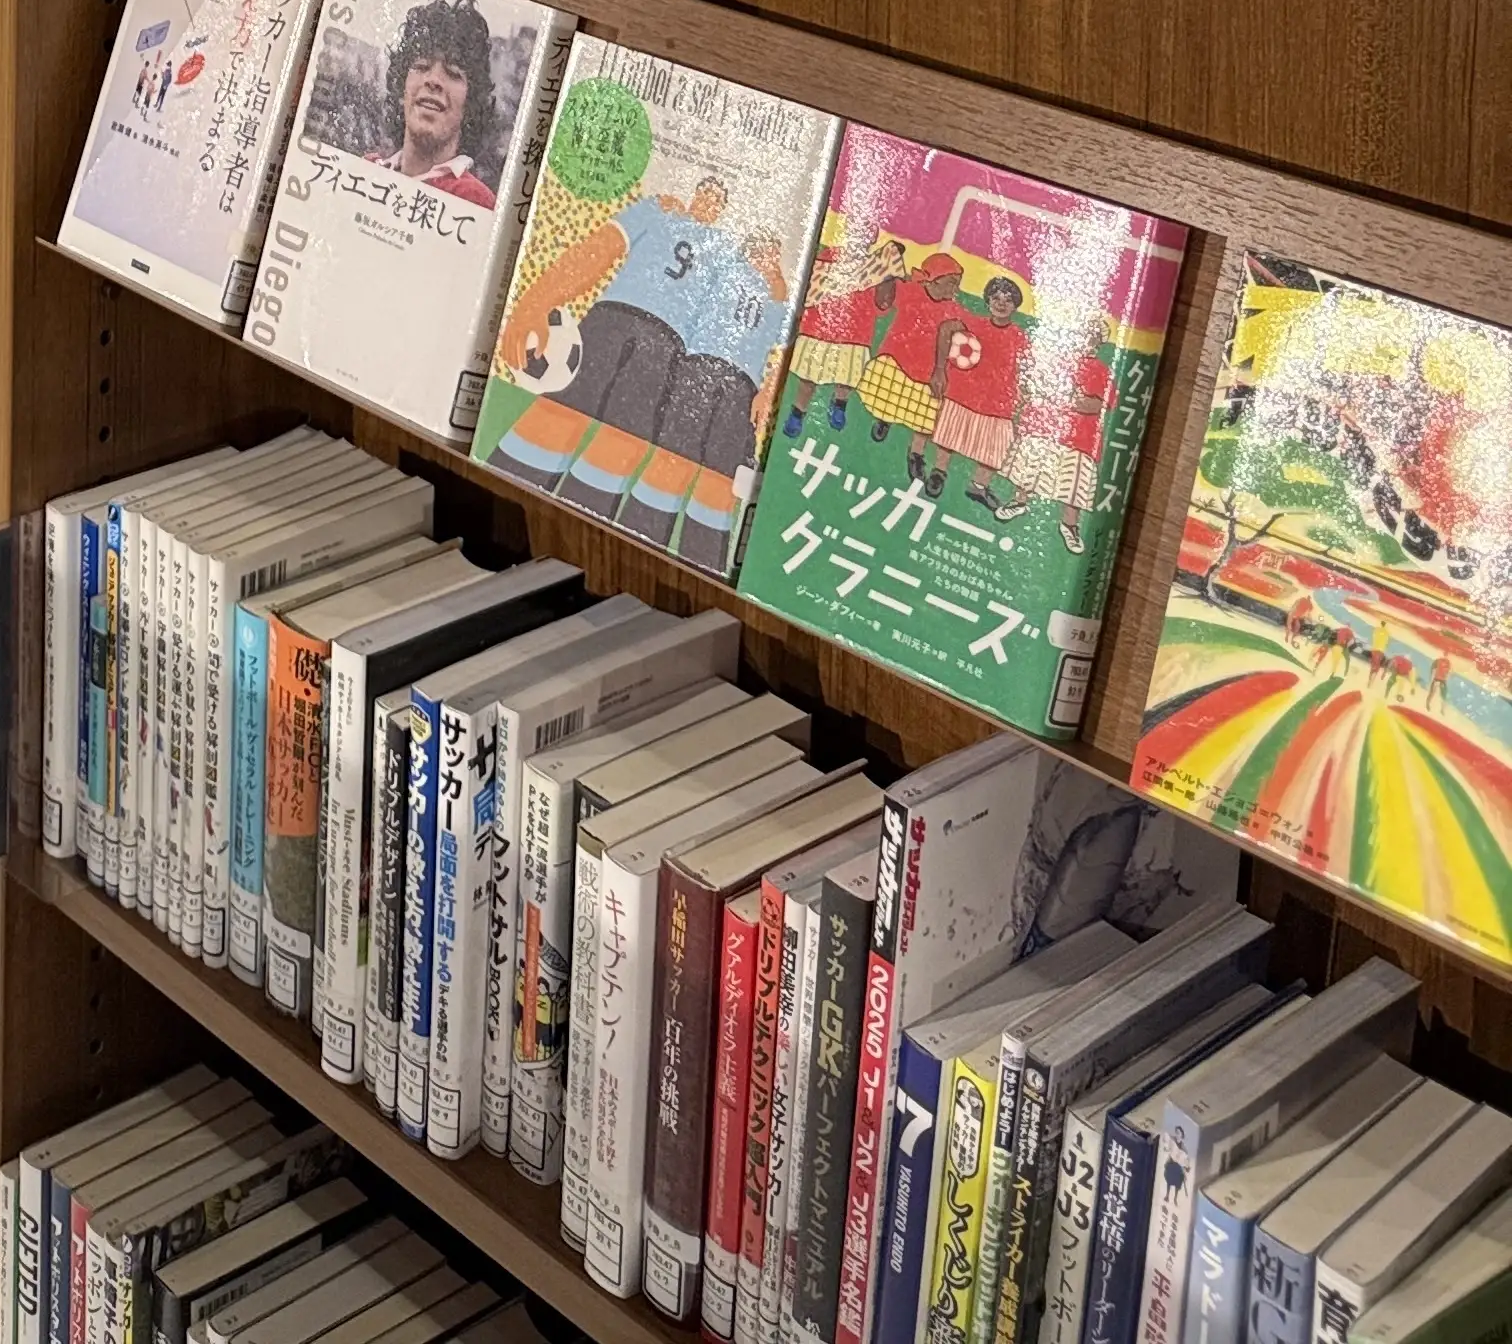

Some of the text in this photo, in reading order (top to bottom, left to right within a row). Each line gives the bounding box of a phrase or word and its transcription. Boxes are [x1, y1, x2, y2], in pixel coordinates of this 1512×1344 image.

[307, 151, 476, 245] ディエゴを探して
[250, 220, 310, 349] Diego
[1096, 358, 1151, 512] グラニーズ
[779, 510, 1041, 666] グラニーズ
[440, 713, 467, 831] サッカー
[338, 875, 356, 947] Stadiums
[572, 856, 600, 1025] 戦術の教科書
[865, 964, 890, 1060] 2025
[656, 1016, 687, 1135] 百年の挑戦
[17, 1206, 39, 1316] GIFTED
[890, 1164, 914, 1275] YASUHITO ENDO
